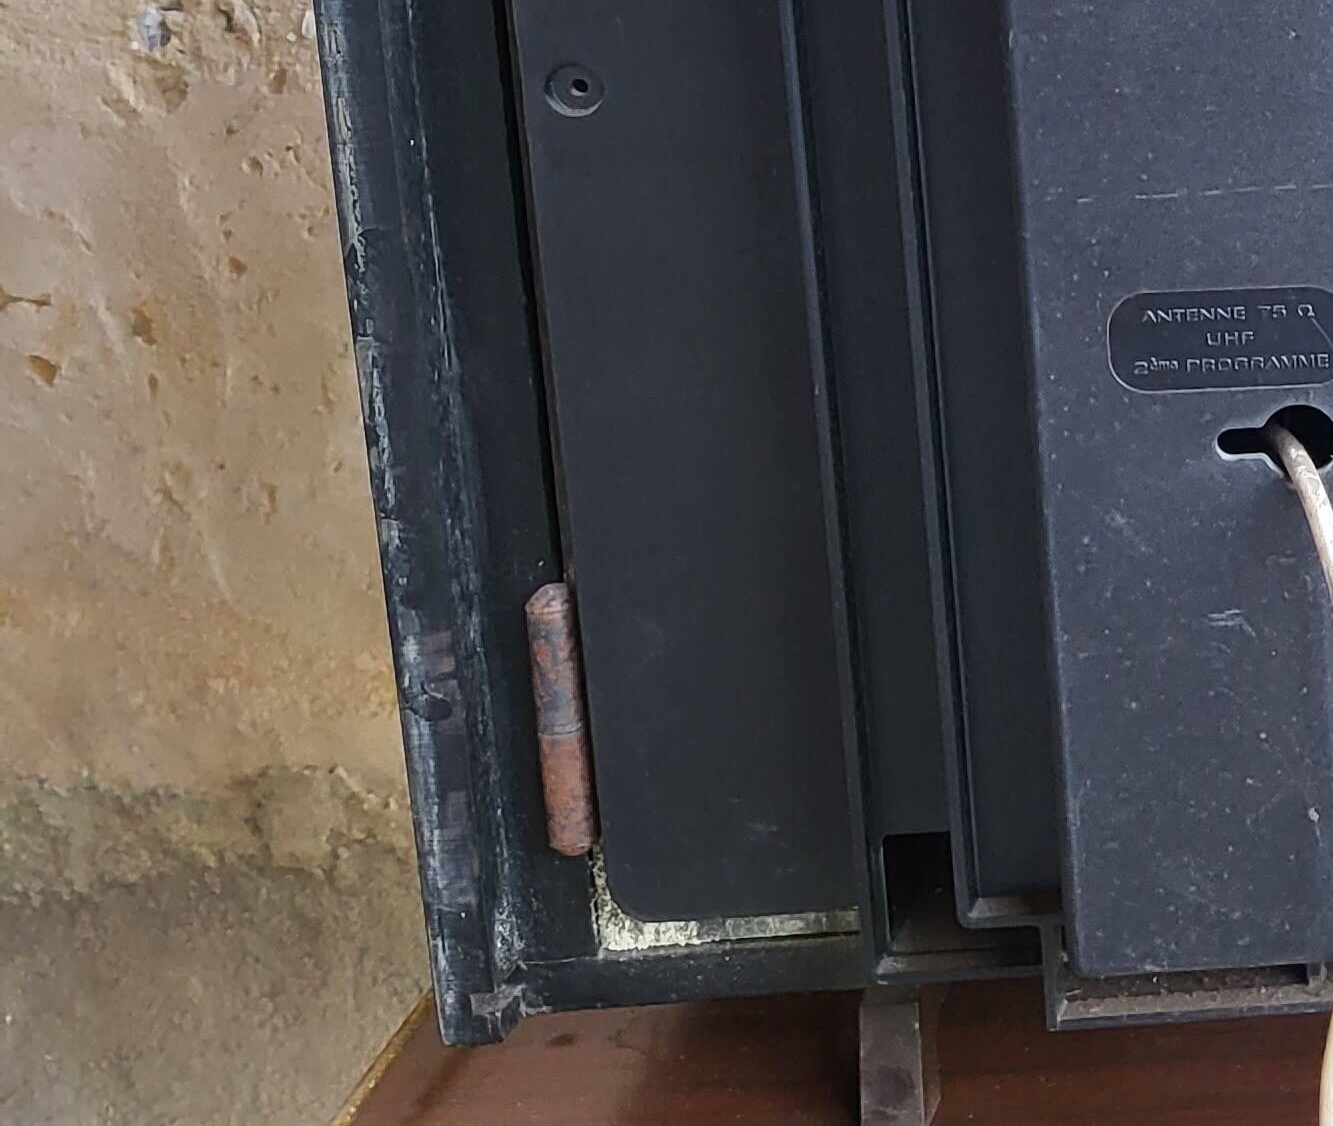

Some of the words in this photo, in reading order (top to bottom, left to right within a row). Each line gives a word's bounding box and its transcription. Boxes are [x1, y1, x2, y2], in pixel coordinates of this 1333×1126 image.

[1142, 305, 1246, 324] ANTENNE
[1257, 304, 1287, 319] 75
[1206, 330, 1255, 346] UHF
[1186, 353, 1330, 373] PROGRAMME
